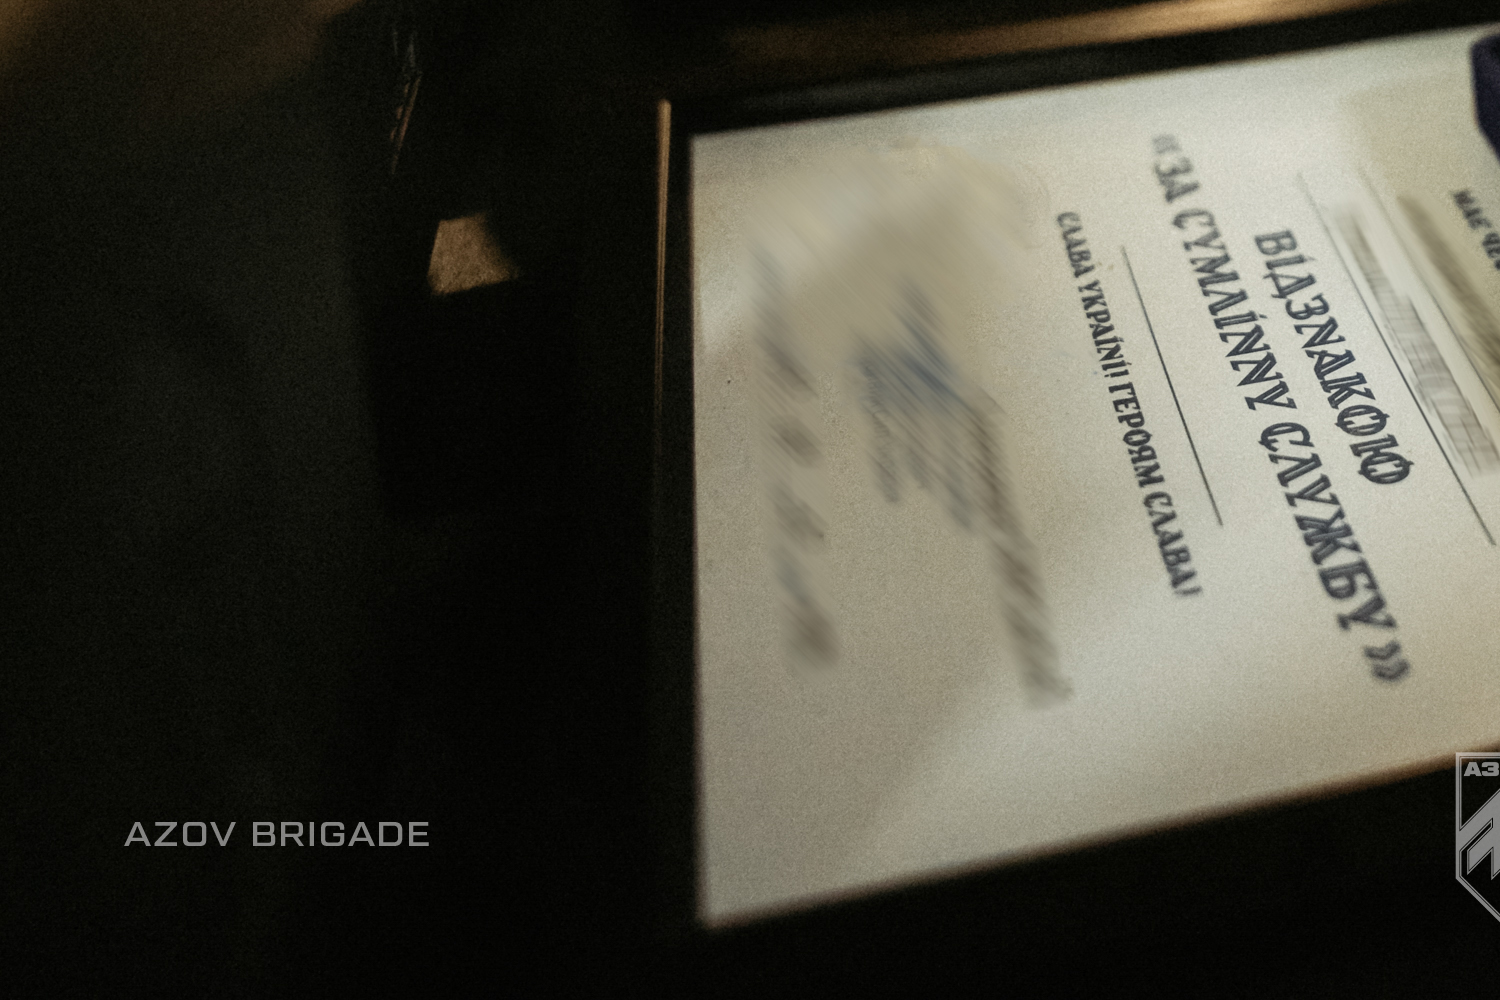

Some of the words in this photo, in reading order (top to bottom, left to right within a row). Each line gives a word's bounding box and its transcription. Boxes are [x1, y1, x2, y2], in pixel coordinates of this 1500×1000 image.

[1056, 211, 1097, 279] СЛАВА
[1107, 381, 1166, 489] ГЕРОЯМ
[1142, 491, 1203, 597] СЛАВА!
[1254, 229, 1415, 485] ВІДЗНАКОЮ
